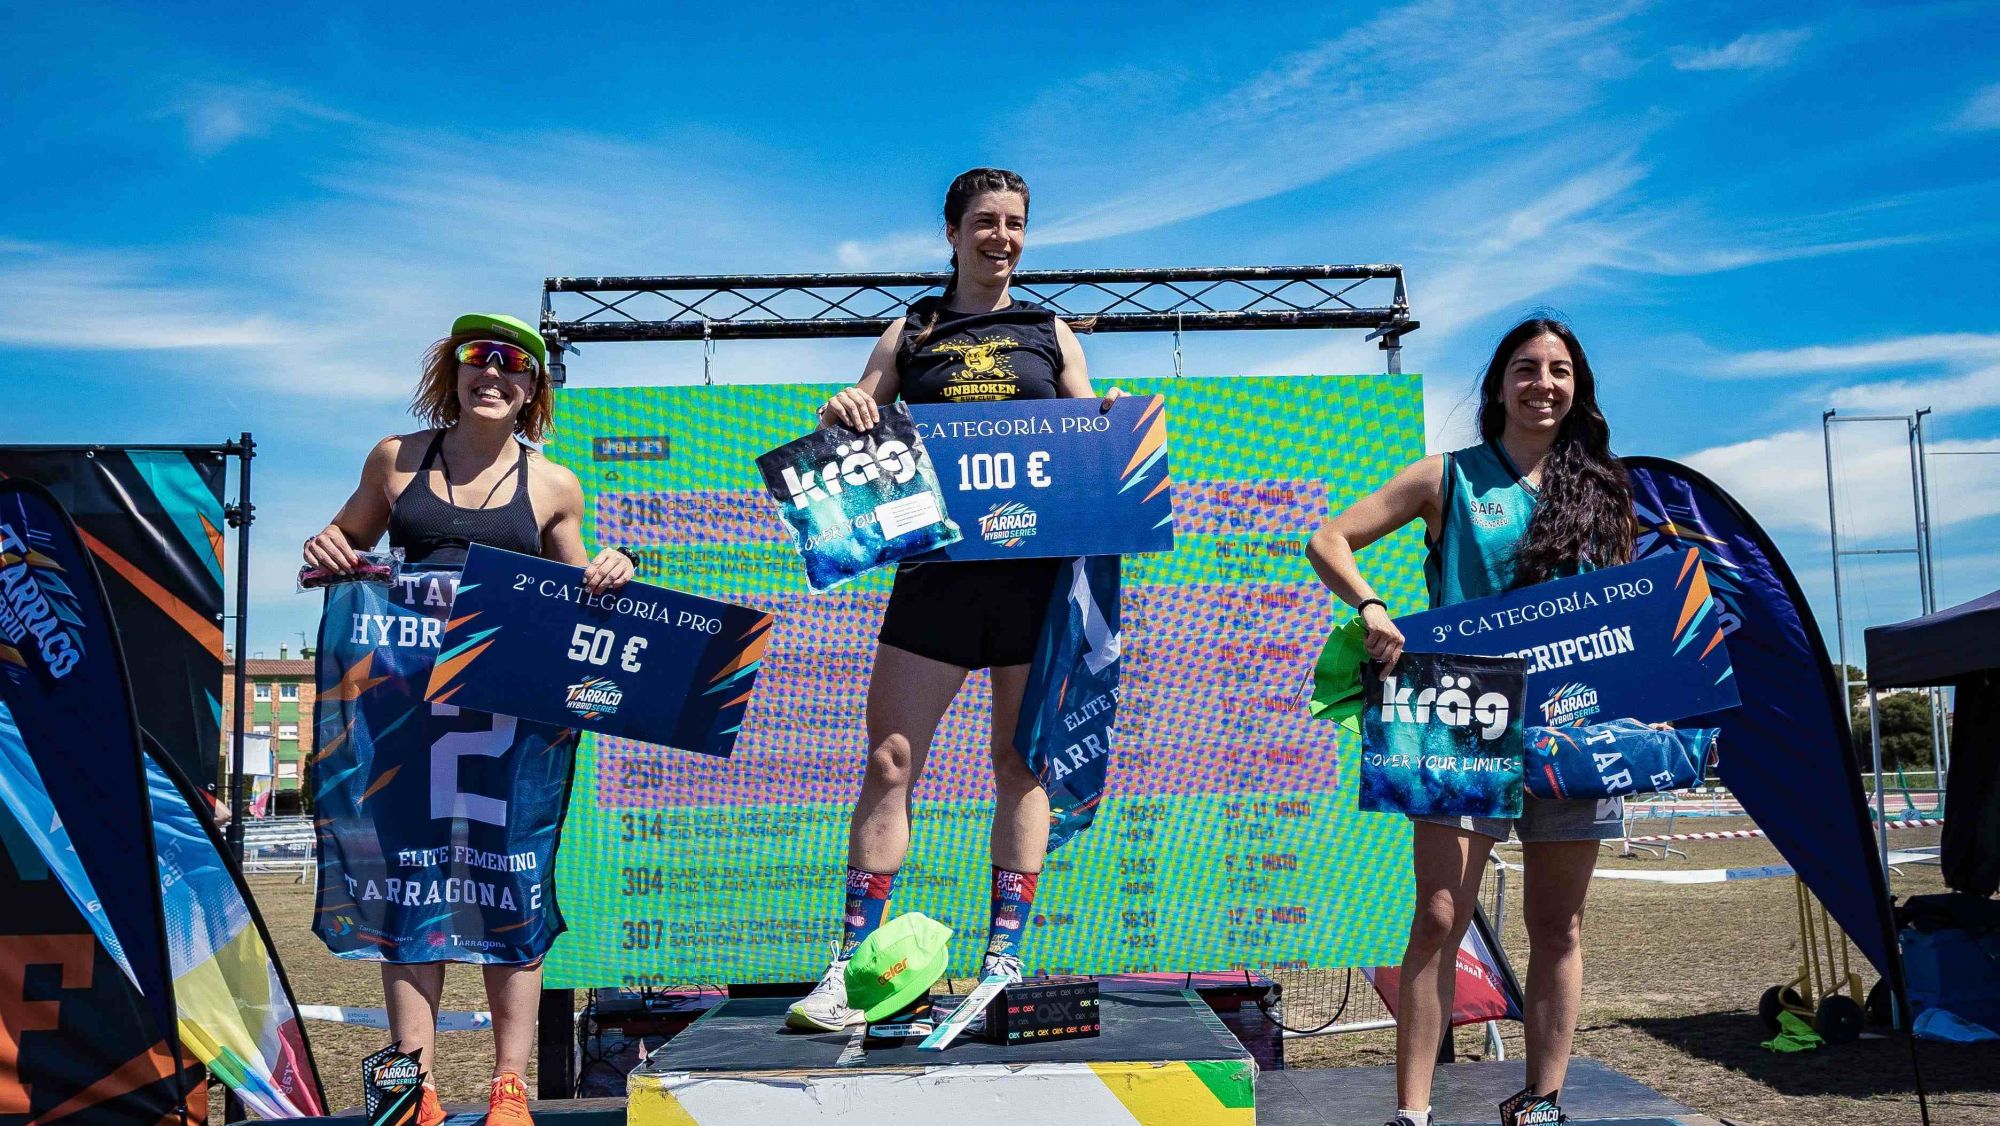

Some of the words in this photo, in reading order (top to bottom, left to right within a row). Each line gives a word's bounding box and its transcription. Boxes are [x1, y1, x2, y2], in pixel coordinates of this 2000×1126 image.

[943, 383, 1016, 397] UNBROKEN
[918, 416, 1053, 439] CATEGORÍA
[1062, 416, 1110, 434] PRO
[958, 452, 1015, 491] 100
[1027, 451, 1052, 488] €
[620, 498, 661, 526] 318
[1470, 500, 1504, 515] SAFA
[978, 513, 1037, 538] TARRACO
[984, 530, 1009, 540] HYBRID
[1010, 528, 1037, 538] SERIES
[638, 550, 661, 577] 09
[513, 573, 536, 592] 2º
[539, 580, 671, 624] CATEGORÍA
[676, 611, 723, 635] PRO
[1432, 623, 1452, 643] 3º
[1458, 589, 1600, 637] CATEGORÍA
[1603, 578, 1654, 604] PRO
[350, 613, 448, 649] HYBR
[567, 623, 616, 666] 50
[621, 636, 648, 673] €
[1500, 625, 1635, 675] CRIPCIÓN
[565, 683, 623, 706] TARRACO
[567, 700, 592, 711] HYBRID
[591, 704, 618, 714] SERIES
[1381, 675, 1509, 740] kräg
[1540, 690, 1598, 721] TARRACO
[1063, 693, 1111, 732] ÉLITE
[1549, 713, 1574, 727] HYBRID
[1574, 704, 1600, 720] SERIES
[1415, 755, 1457, 771] YOUR
[621, 813, 663, 842] 314
[398, 847, 450, 868] ÉLITE
[454, 845, 537, 873] FEMENINO
[622, 866, 664, 896] 304
[848, 879, 870, 890] ALM
[997, 880, 1022, 894] CALM
[998, 870, 1023, 883] KEEP
[344, 877, 518, 912] TARRAGONA
[622, 920, 664, 950] 307
[373, 1065, 418, 1083] TARRACO
[376, 1079, 396, 1087] HYBRID
[396, 1077, 417, 1085] SERIES
[1514, 1109, 1559, 1126] TARRACO
